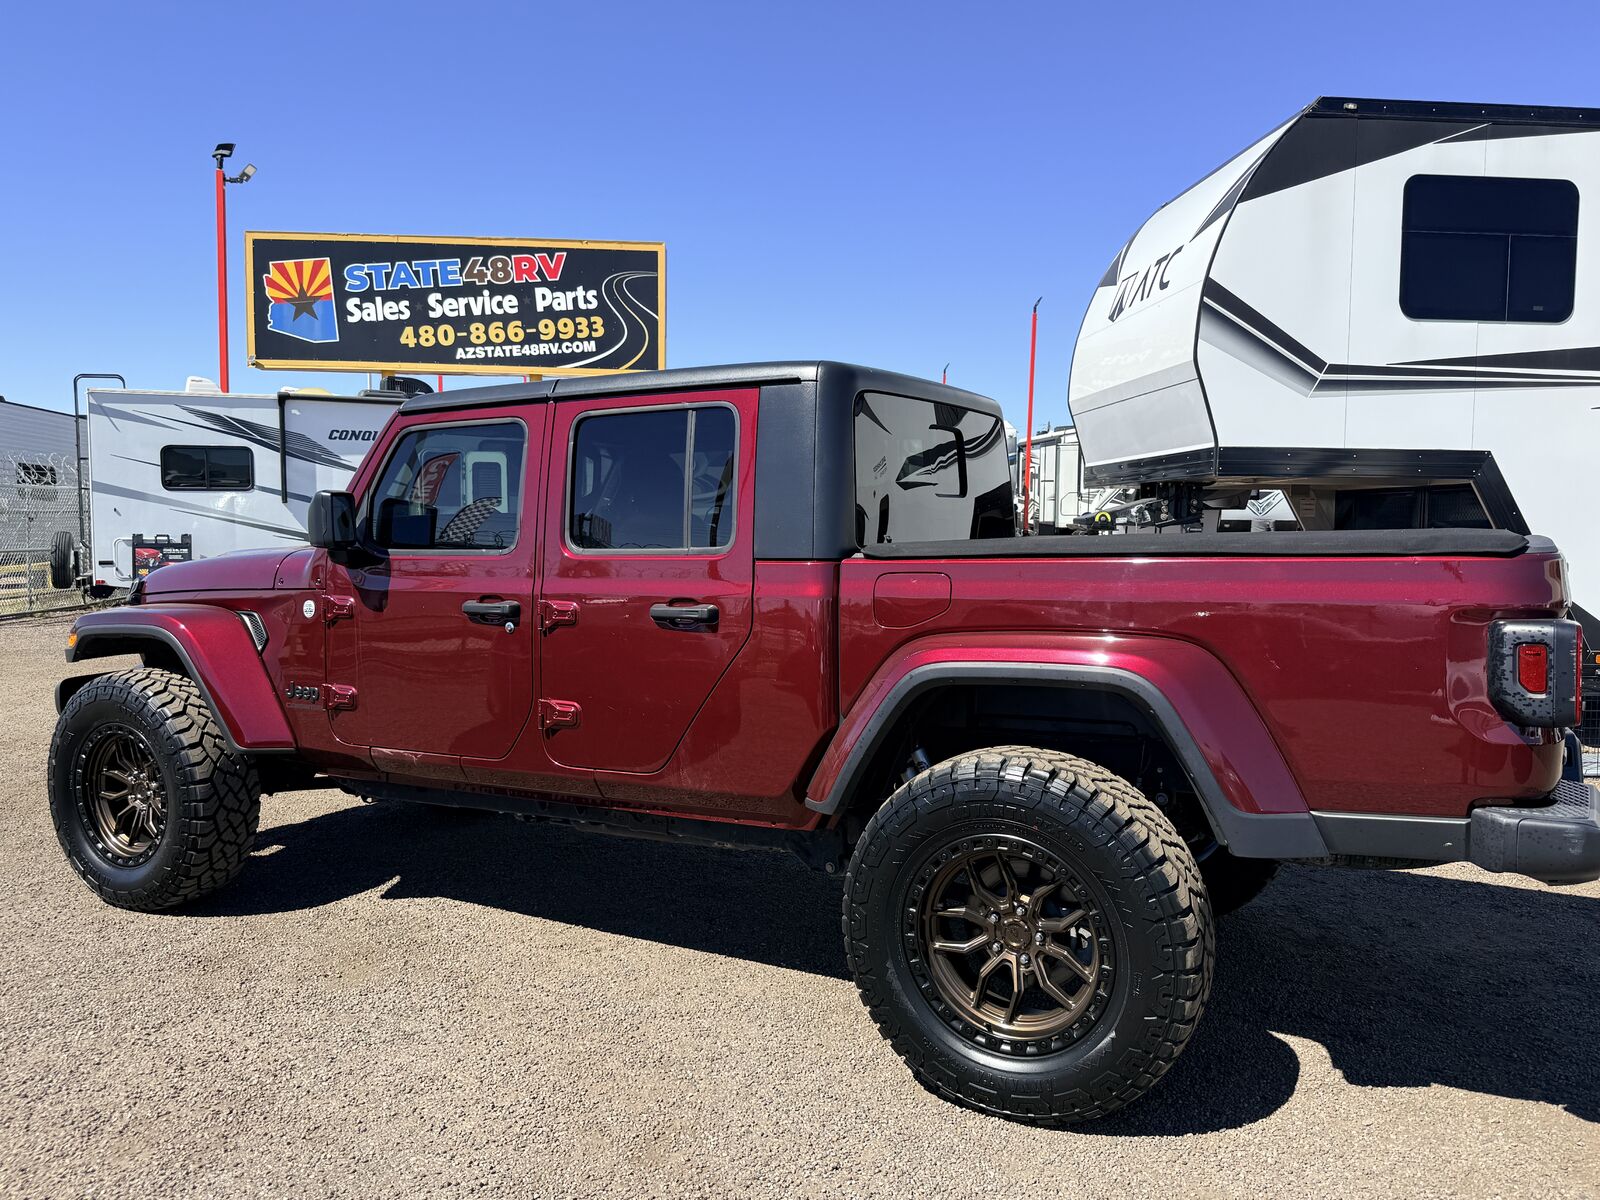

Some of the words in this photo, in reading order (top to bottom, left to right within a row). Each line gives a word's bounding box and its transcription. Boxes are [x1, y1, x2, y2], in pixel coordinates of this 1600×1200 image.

[344, 252, 567, 292] STATE48RV
[1129, 244, 1185, 308] ATC
[346, 297, 411, 323] Sales
[427, 292, 519, 318] Service
[535, 285, 599, 312] Parts
[400, 316, 605, 348] 480-866-9933
[455, 340, 597, 360] AZSTATE48RV.COM
[285, 680, 319, 704] Jeep
